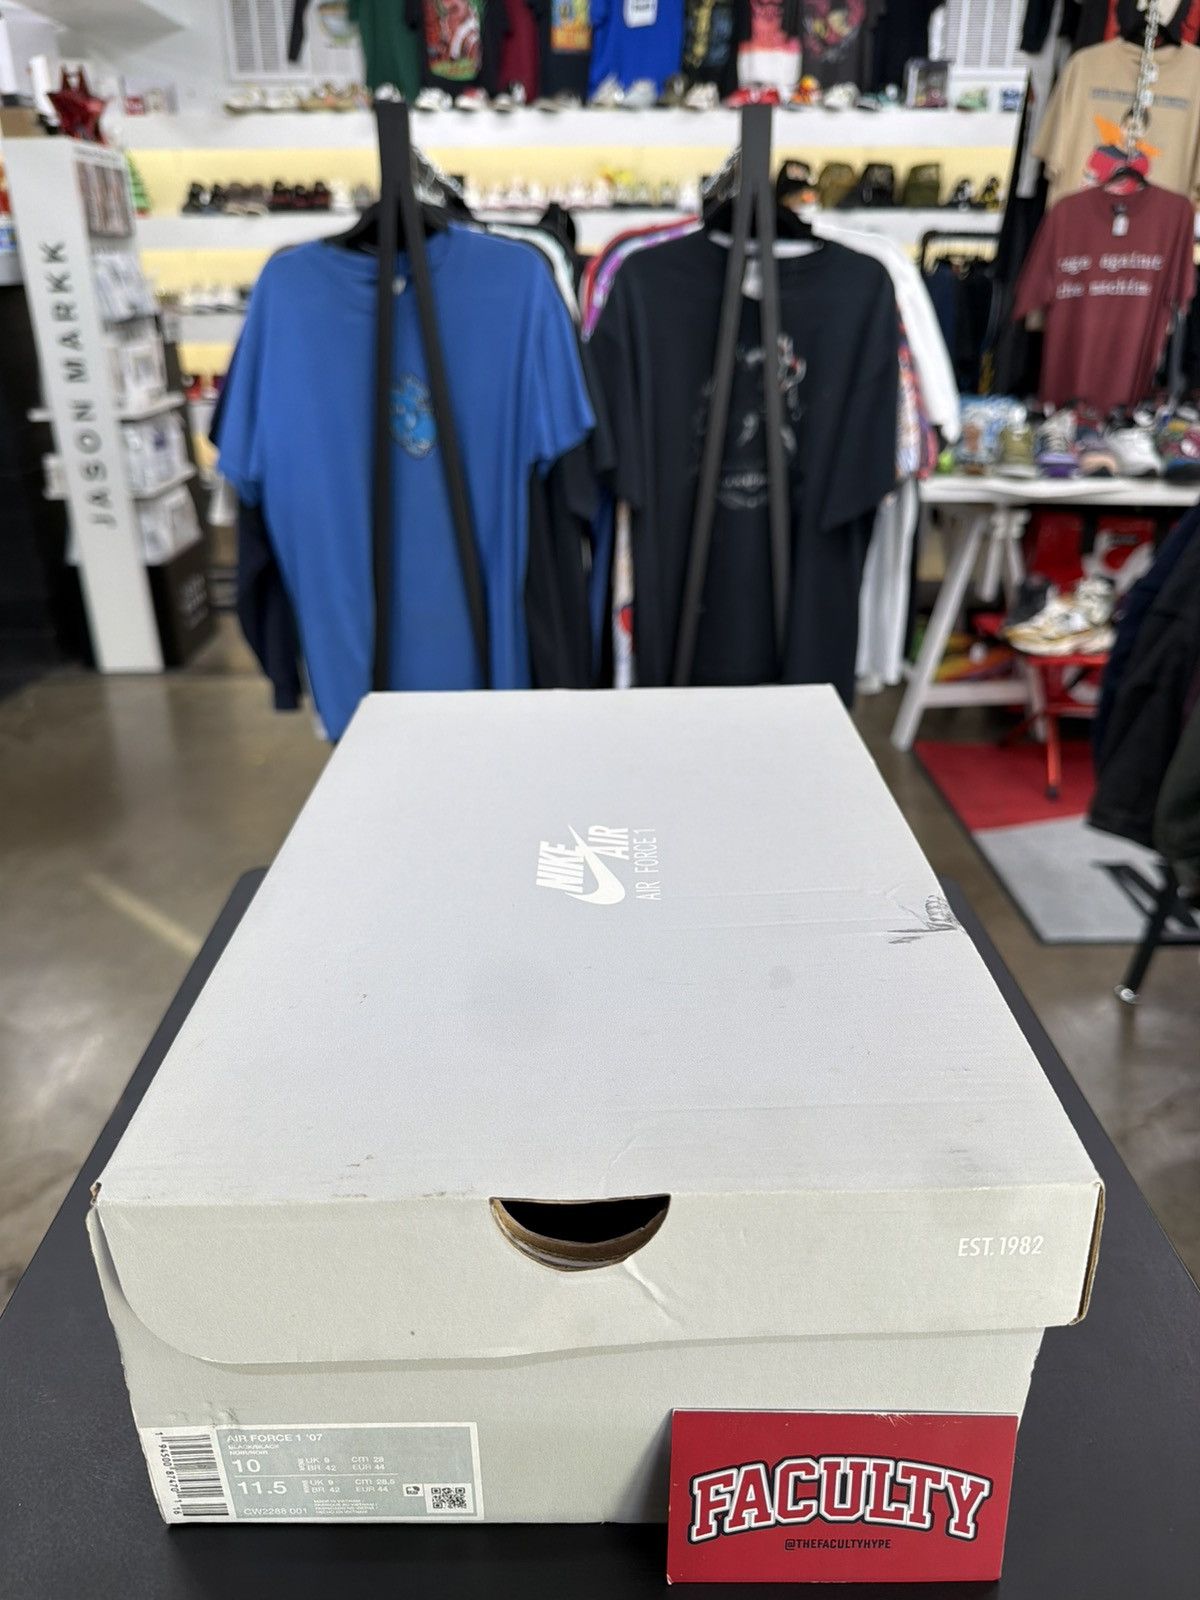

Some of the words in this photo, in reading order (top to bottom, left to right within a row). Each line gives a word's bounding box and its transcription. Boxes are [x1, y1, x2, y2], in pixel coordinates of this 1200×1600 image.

[39, 242, 89, 383] MARKK
[68, 400, 117, 526] JASON
[586, 825, 629, 860] AIR
[633, 837, 659, 873] FORCE
[536, 840, 584, 893] NIKE
[635, 879, 662, 900] AIR
[958, 1236, 994, 1257] EST.
[1000, 1235, 1044, 1256] 1982
[226, 1434, 247, 1443] AIR
[251, 1434, 293, 1442] FORCE
[295, 1434, 301, 1442] 1
[306, 1433, 323, 1442] '07
[232, 1458, 261, 1473] 10
[237, 1480, 288, 1495] 11.5
[690, 1454, 991, 1543] FACULTY
[243, 1507, 287, 1515] CW2288
[289, 1507, 308, 1515] 001
[785, 1538, 891, 1550] @THEFACULTYHYPE
